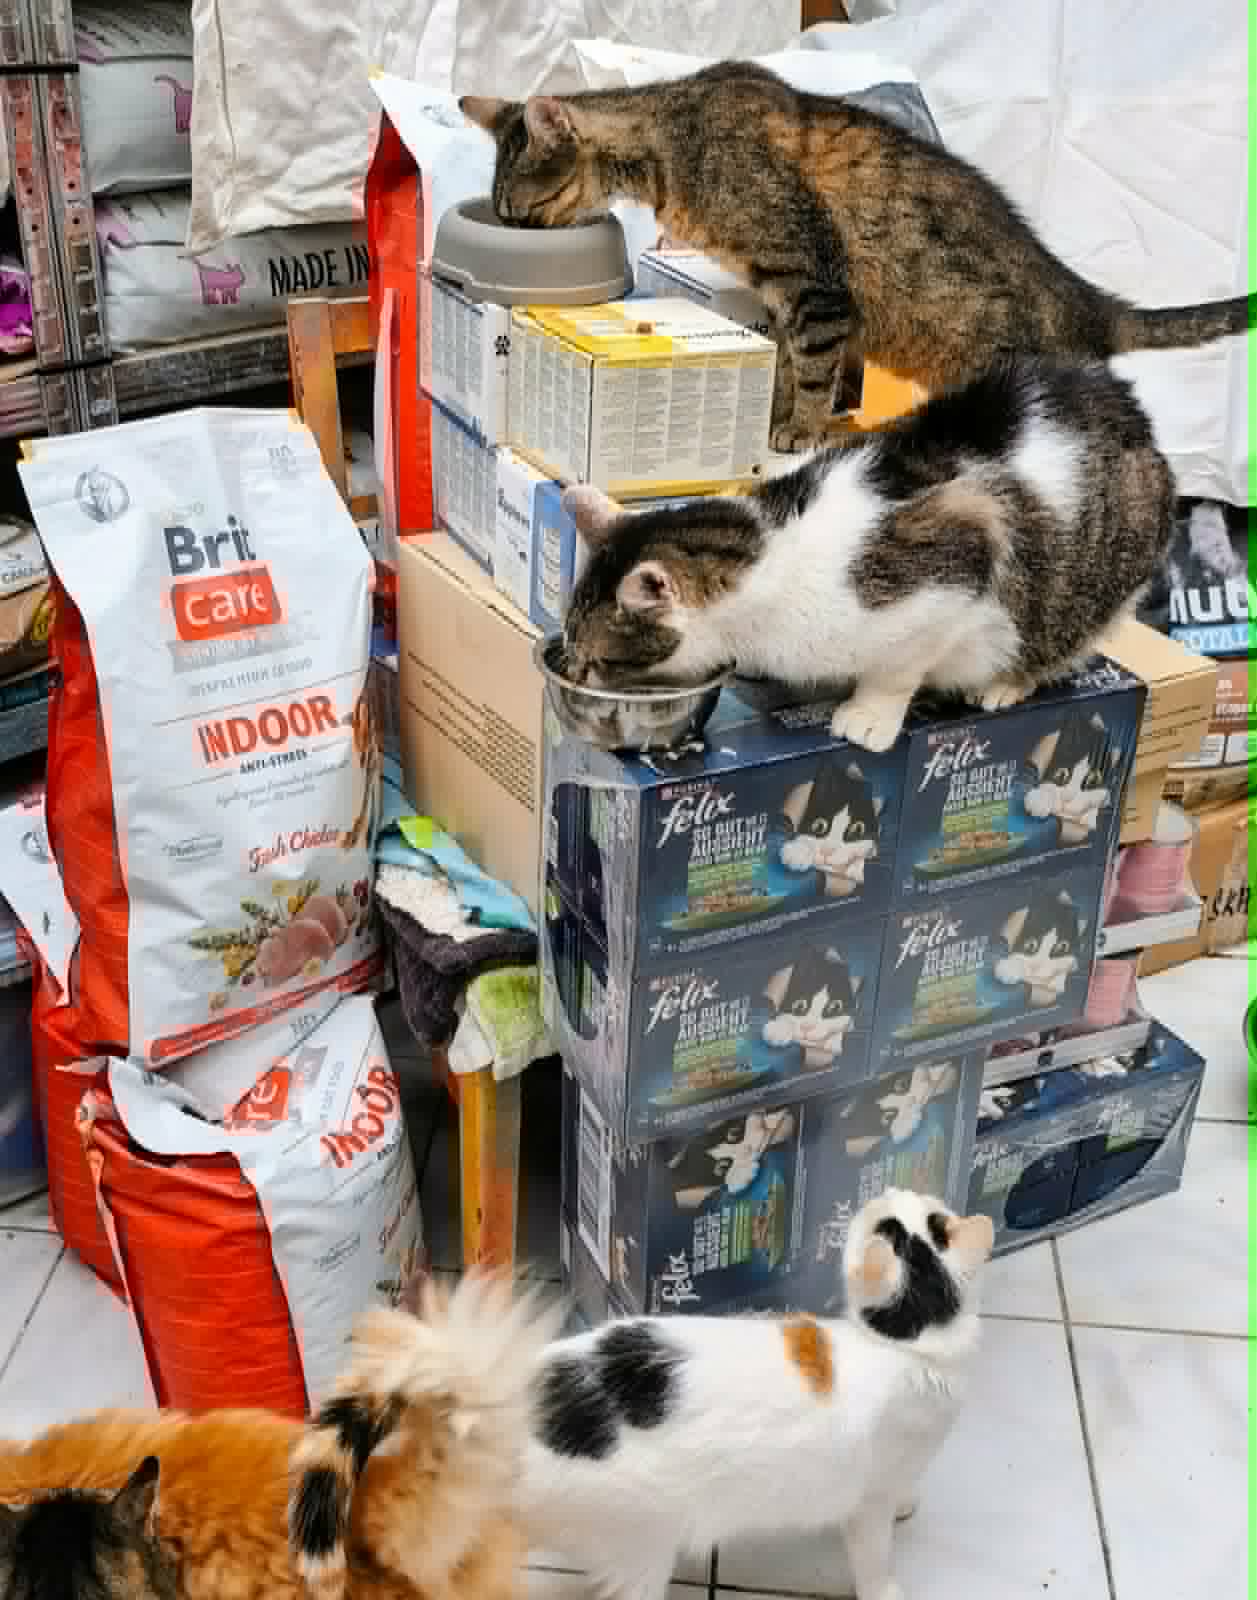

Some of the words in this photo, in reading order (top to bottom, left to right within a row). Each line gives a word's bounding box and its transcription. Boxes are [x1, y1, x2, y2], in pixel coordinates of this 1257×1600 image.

[268, 249, 344, 296] MADE
[163, 513, 257, 577] Brit
[198, 695, 338, 765] INDOOR
[656, 789, 736, 849] felix
